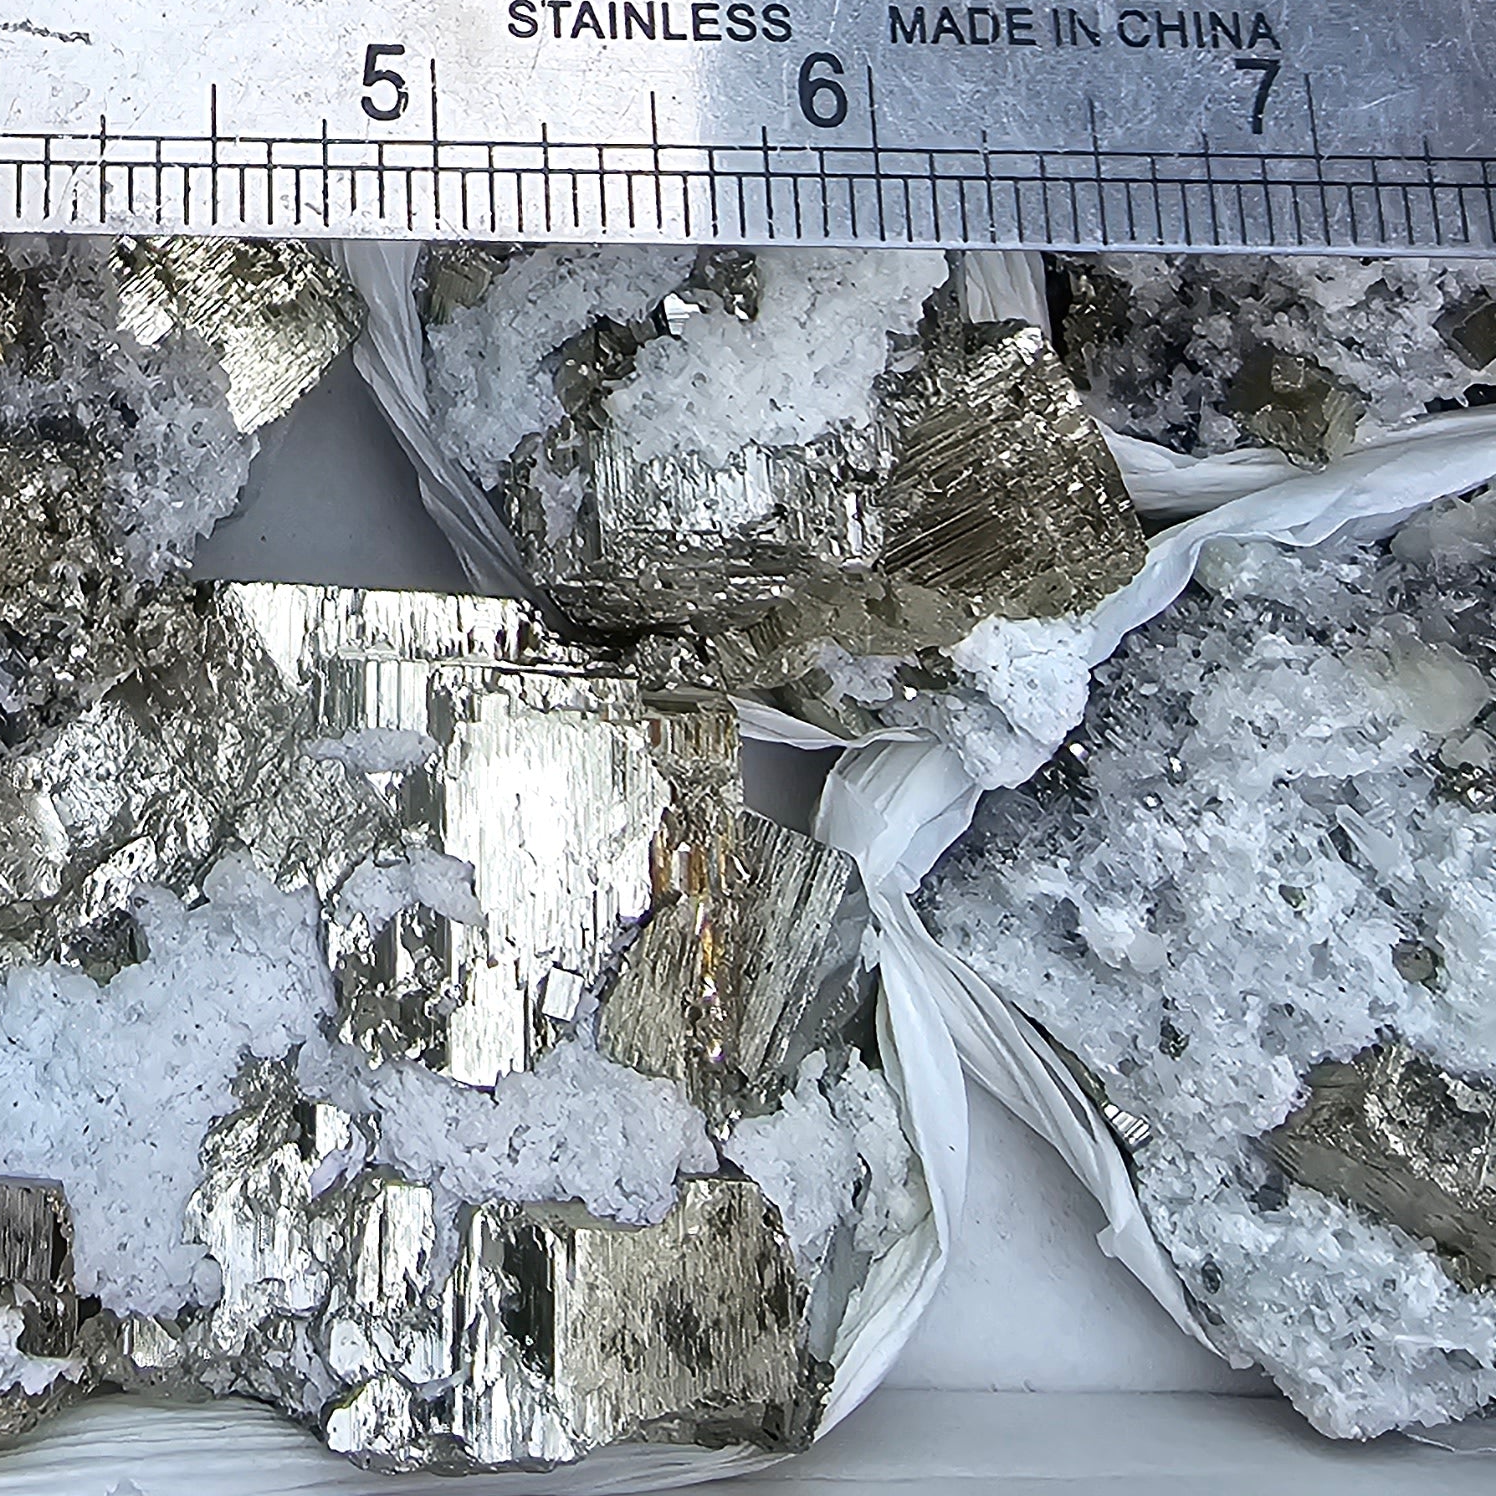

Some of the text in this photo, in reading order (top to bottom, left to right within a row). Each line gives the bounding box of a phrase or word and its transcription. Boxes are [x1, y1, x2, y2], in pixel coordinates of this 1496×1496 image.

[507, 0, 793, 43] STAINLESS
[888, 4, 1282, 50] MADE IN CHINA
[360, 44, 408, 122] 5
[798, 52, 848, 128] 6
[1234, 58, 1281, 135] 7
